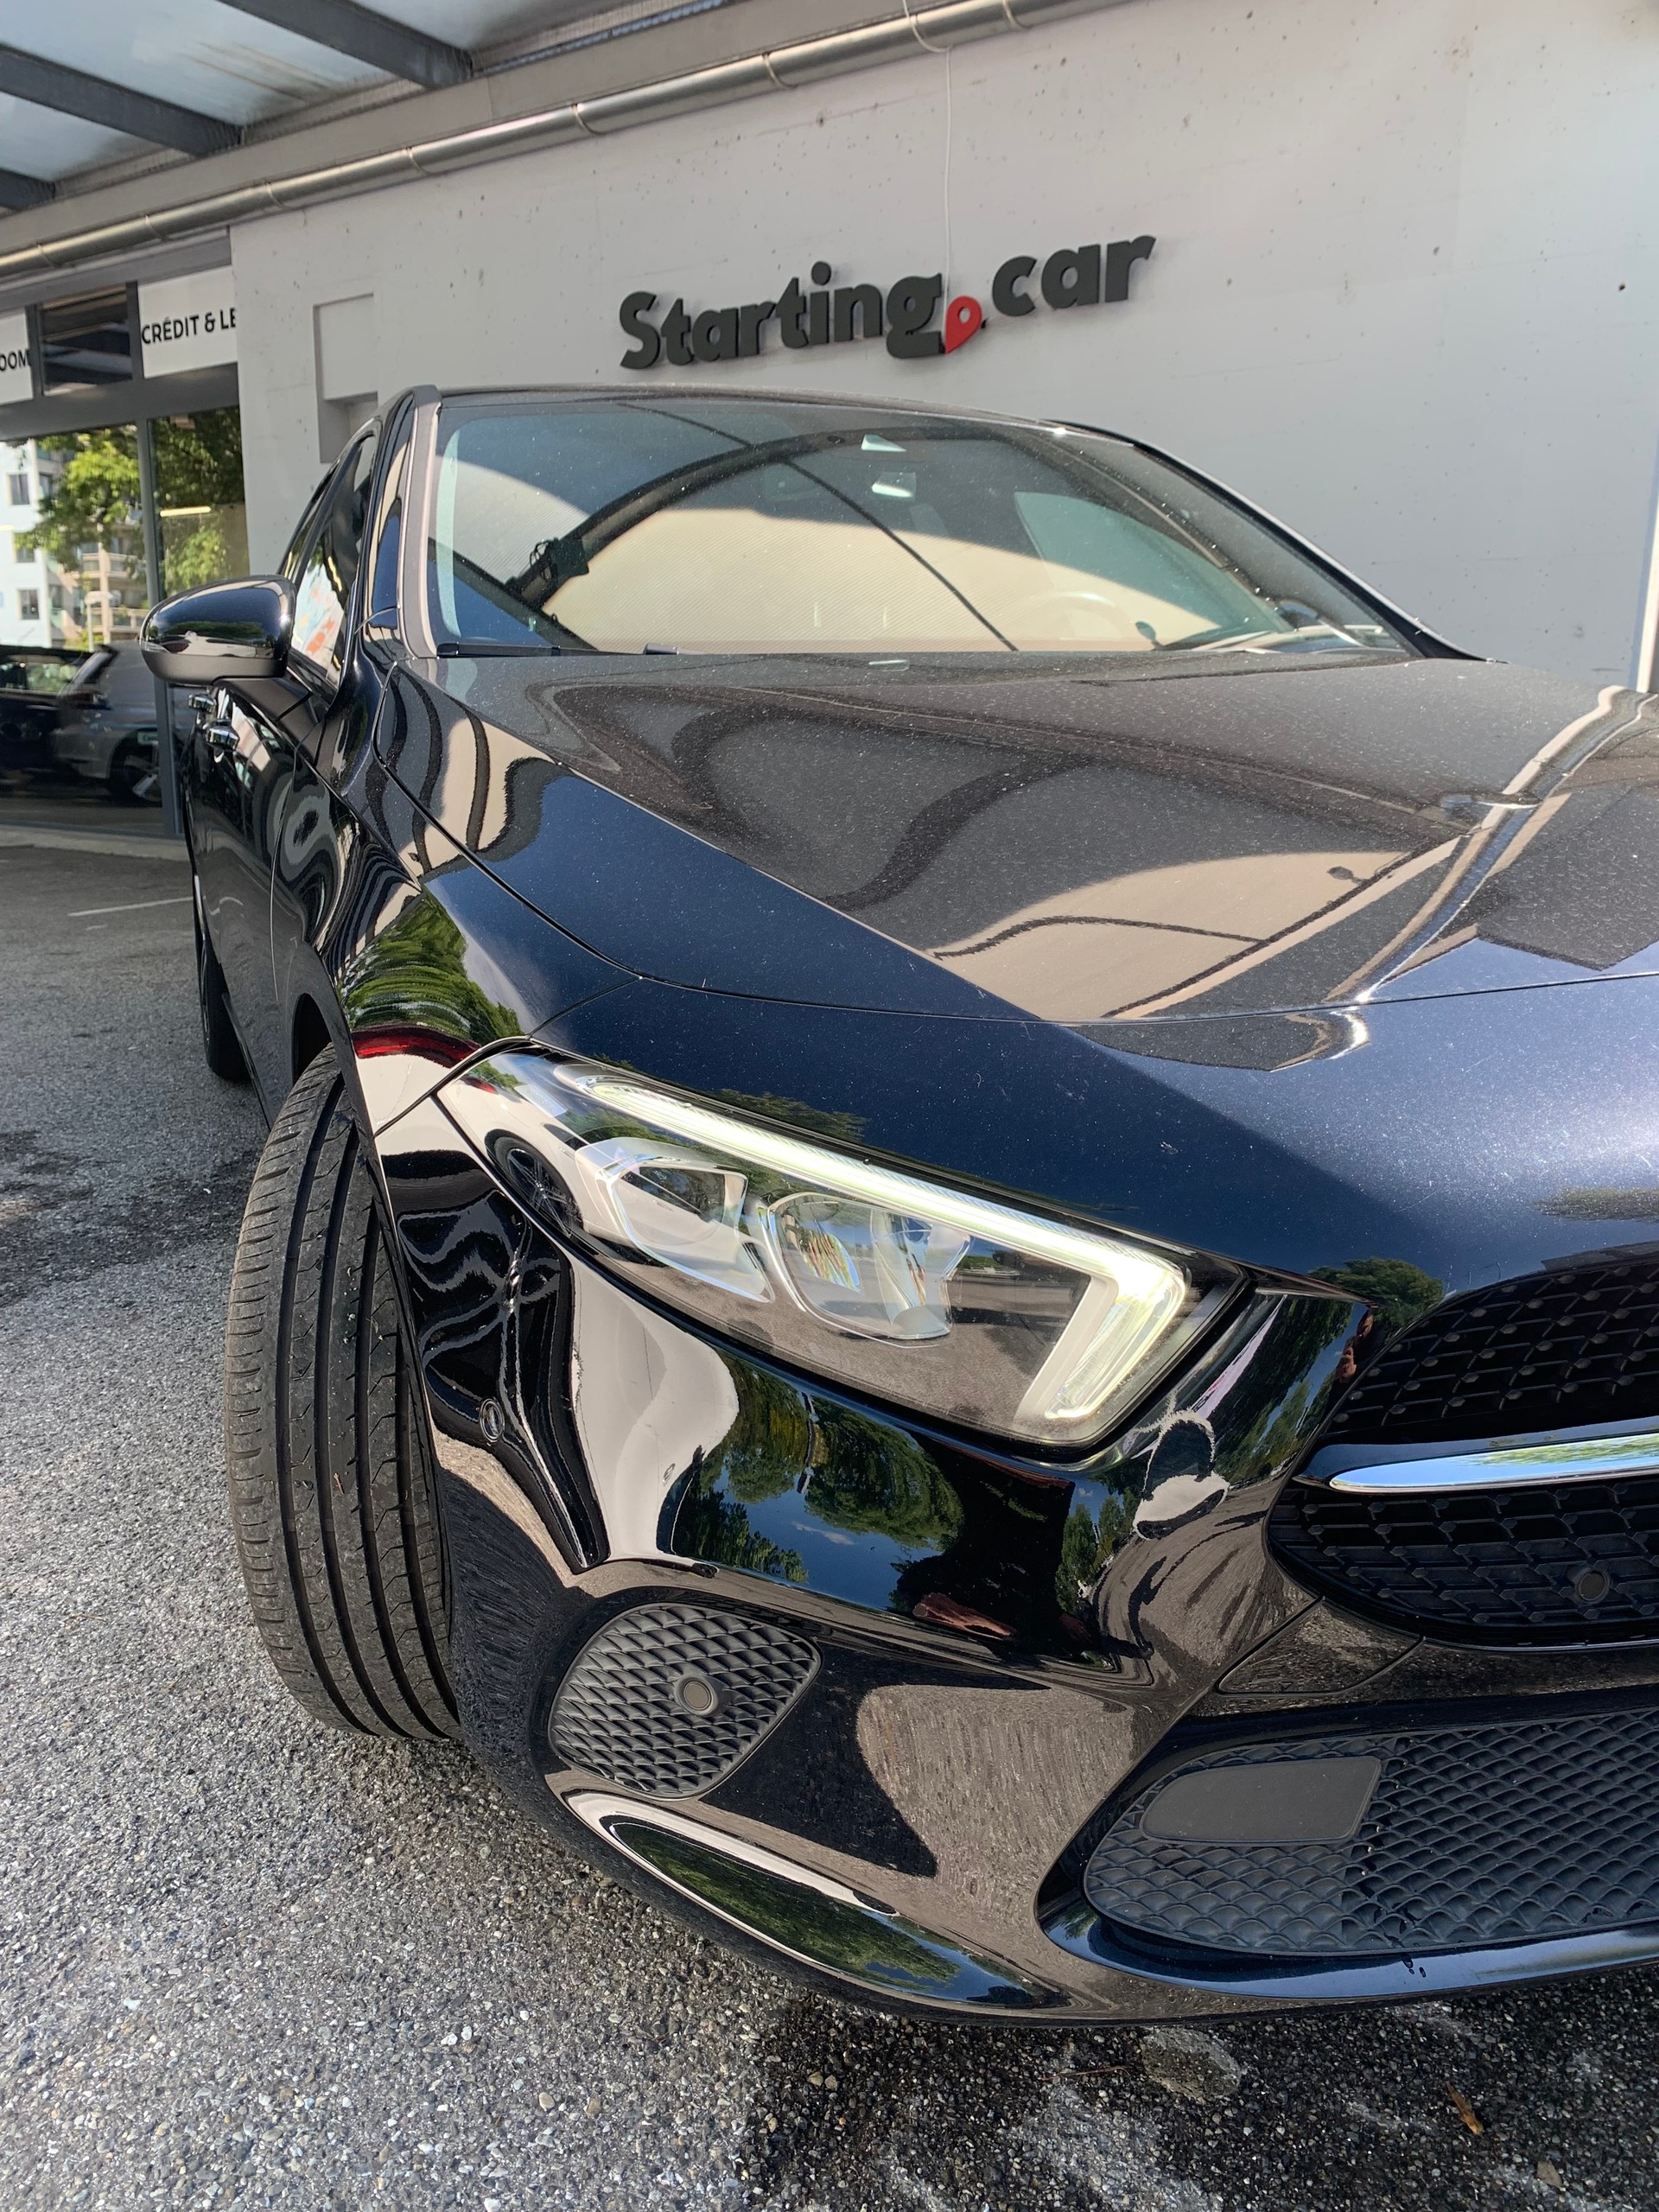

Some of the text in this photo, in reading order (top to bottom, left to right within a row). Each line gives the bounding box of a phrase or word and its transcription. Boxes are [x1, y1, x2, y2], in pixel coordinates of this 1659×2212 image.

[142, 316, 199, 344] CRÉDIT
[205, 312, 215, 333] &
[619, 234, 1156, 369] Starting car
